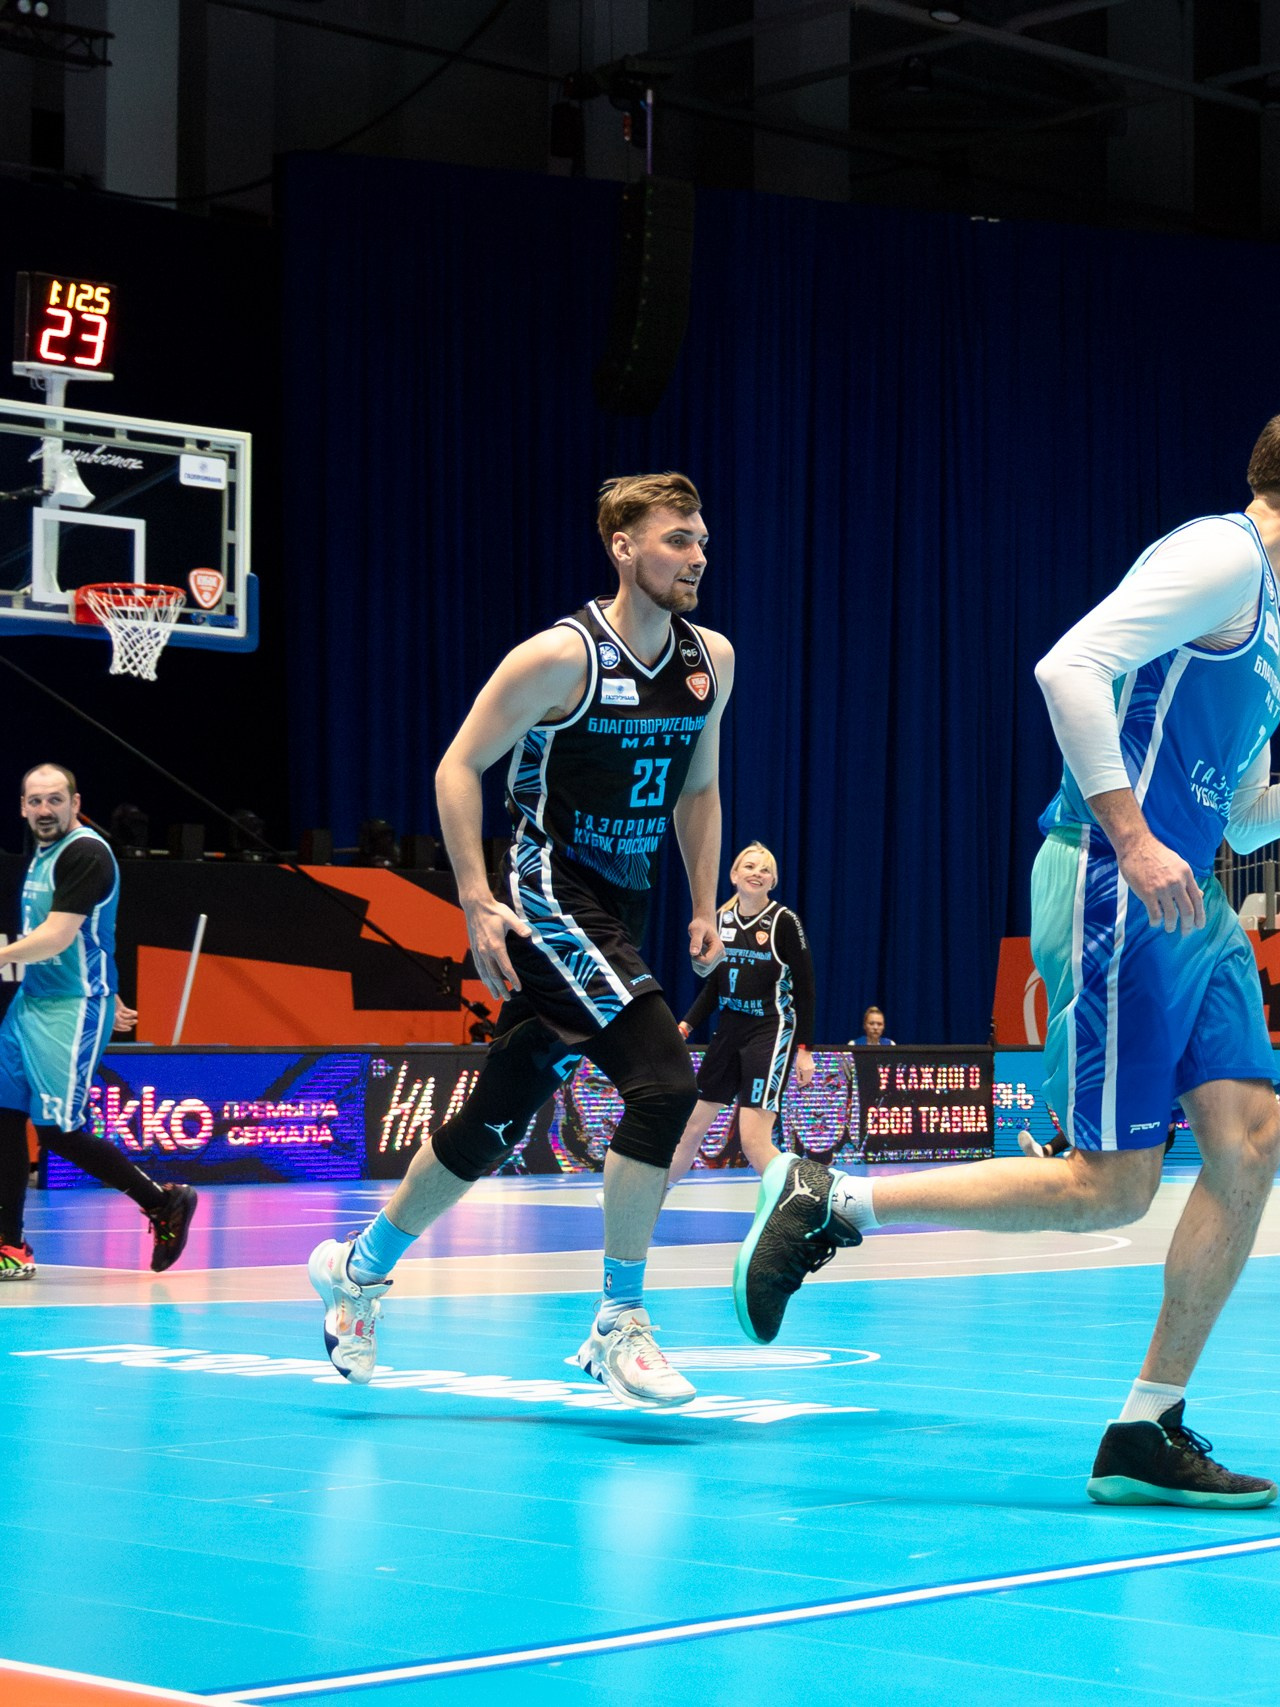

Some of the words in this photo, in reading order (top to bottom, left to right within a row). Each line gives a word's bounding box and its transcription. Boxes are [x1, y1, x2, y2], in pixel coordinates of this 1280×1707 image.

[40, 307, 107, 366] 23
[621, 735, 691, 749] МАТЧ
[630, 758, 671, 807] 23
[750, 1078, 765, 1103] 8
